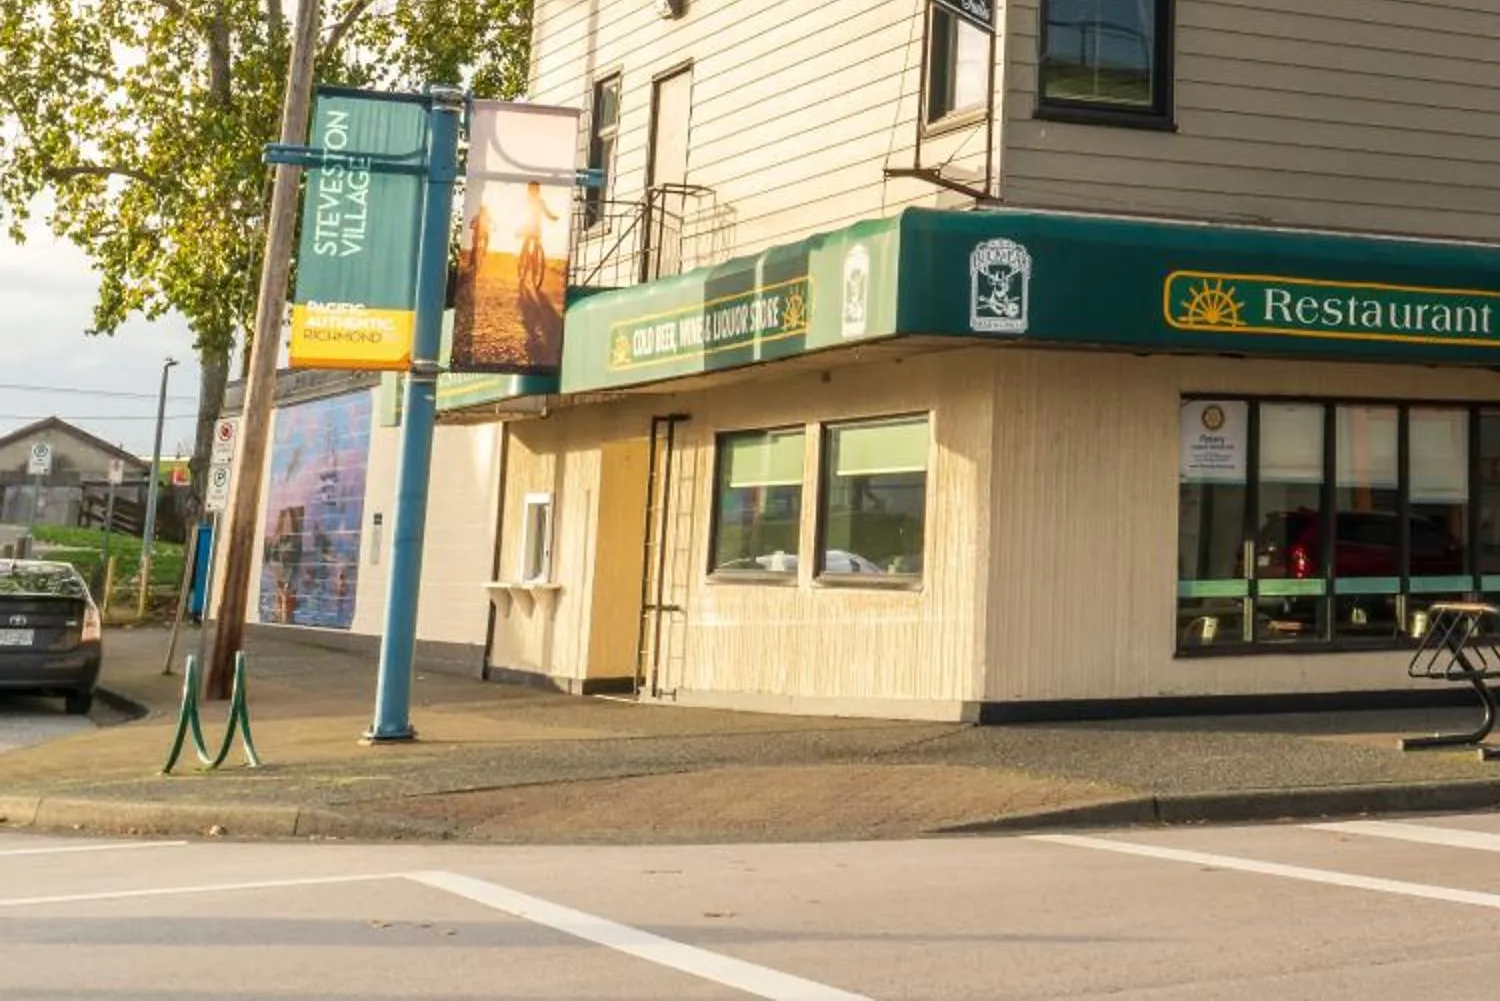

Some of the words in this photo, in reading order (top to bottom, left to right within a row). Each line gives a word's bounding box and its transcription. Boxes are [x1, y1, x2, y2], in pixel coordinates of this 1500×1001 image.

[314, 110, 350, 257] STEVESTON
[339, 156, 371, 257] VILLAGE
[303, 329, 383, 344] RICHMOND
[633, 325, 656, 357] COLD
[679, 313, 703, 347] WINE
[713, 303, 749, 341] LIQUOR
[750, 295, 780, 331] STORE
[1263, 288, 1492, 334] Restaurant
